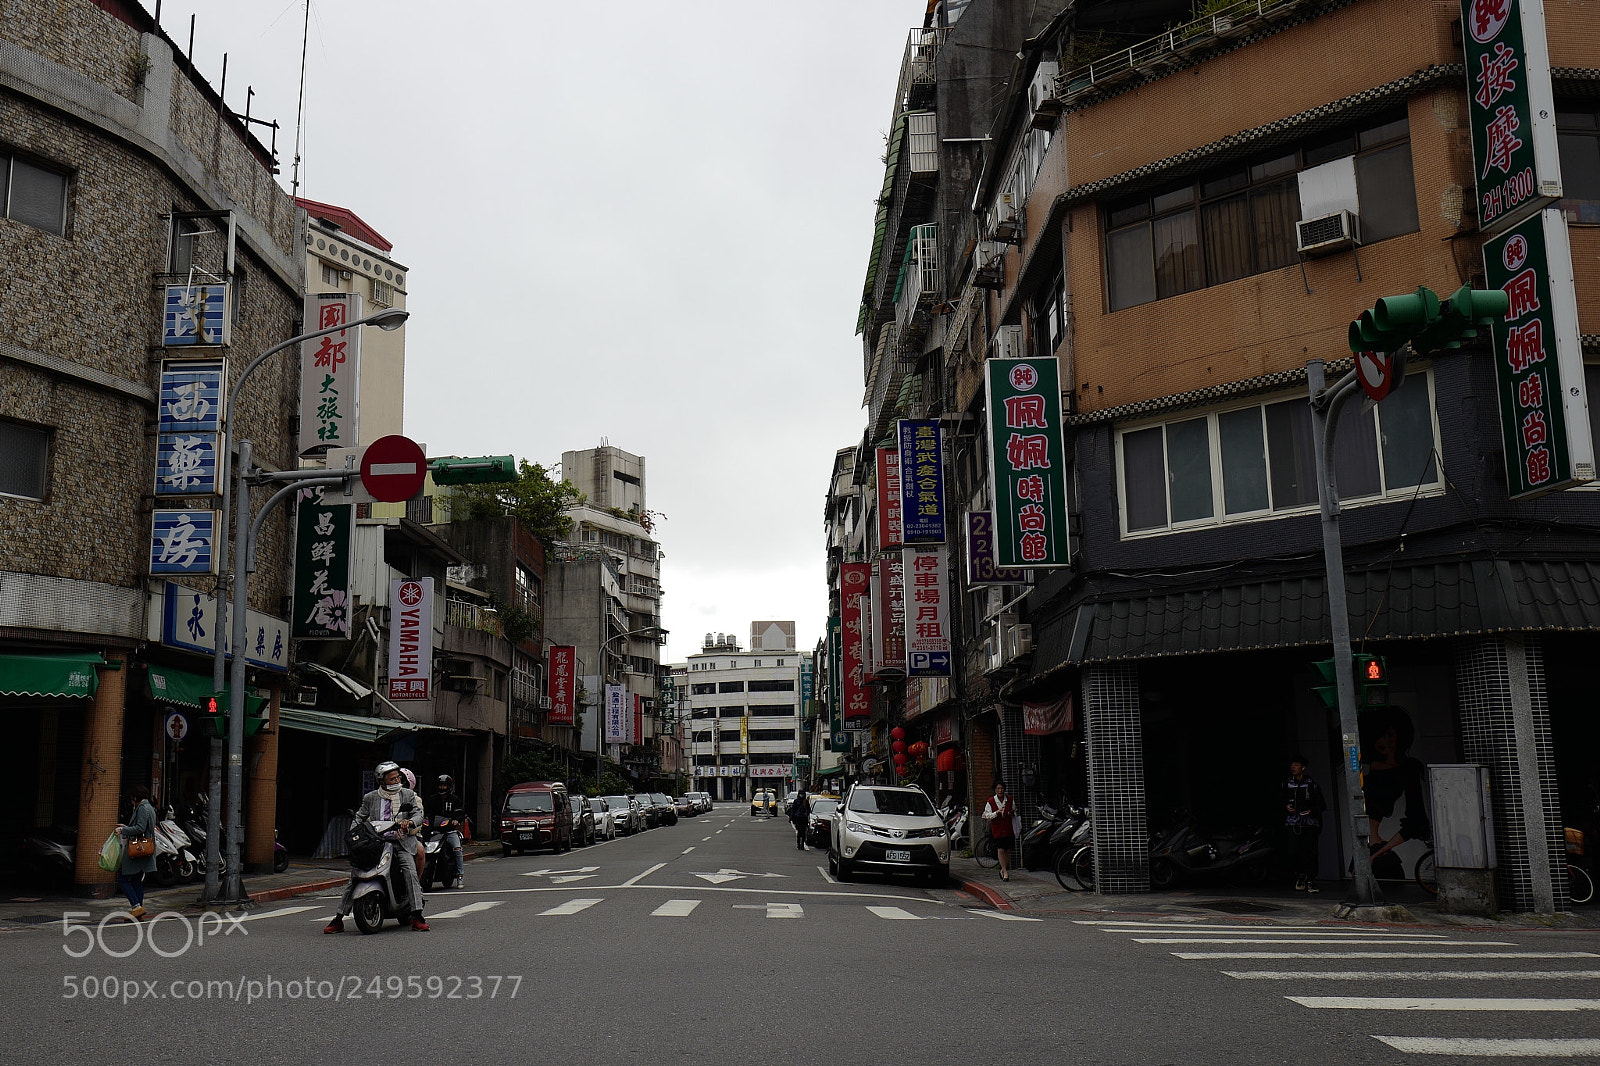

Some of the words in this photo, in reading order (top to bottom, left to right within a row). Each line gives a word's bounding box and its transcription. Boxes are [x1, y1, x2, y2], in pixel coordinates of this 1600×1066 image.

[1475, 42, 1523, 180] 按摩
[1483, 184, 1503, 222] 2H
[1503, 166, 1535, 209] 1300
[313, 302, 348, 442] 國都大旅社
[1013, 367, 1033, 387] 純
[915, 426, 940, 516] 臺灣武產合氣道
[973, 515, 992, 537] 2
[976, 539, 993, 553] 2
[187, 593, 284, 661] 永藥房
[914, 556, 942, 638] 停車場月租
[398, 608, 421, 677] YAMAHA
[913, 653, 928, 668] P
